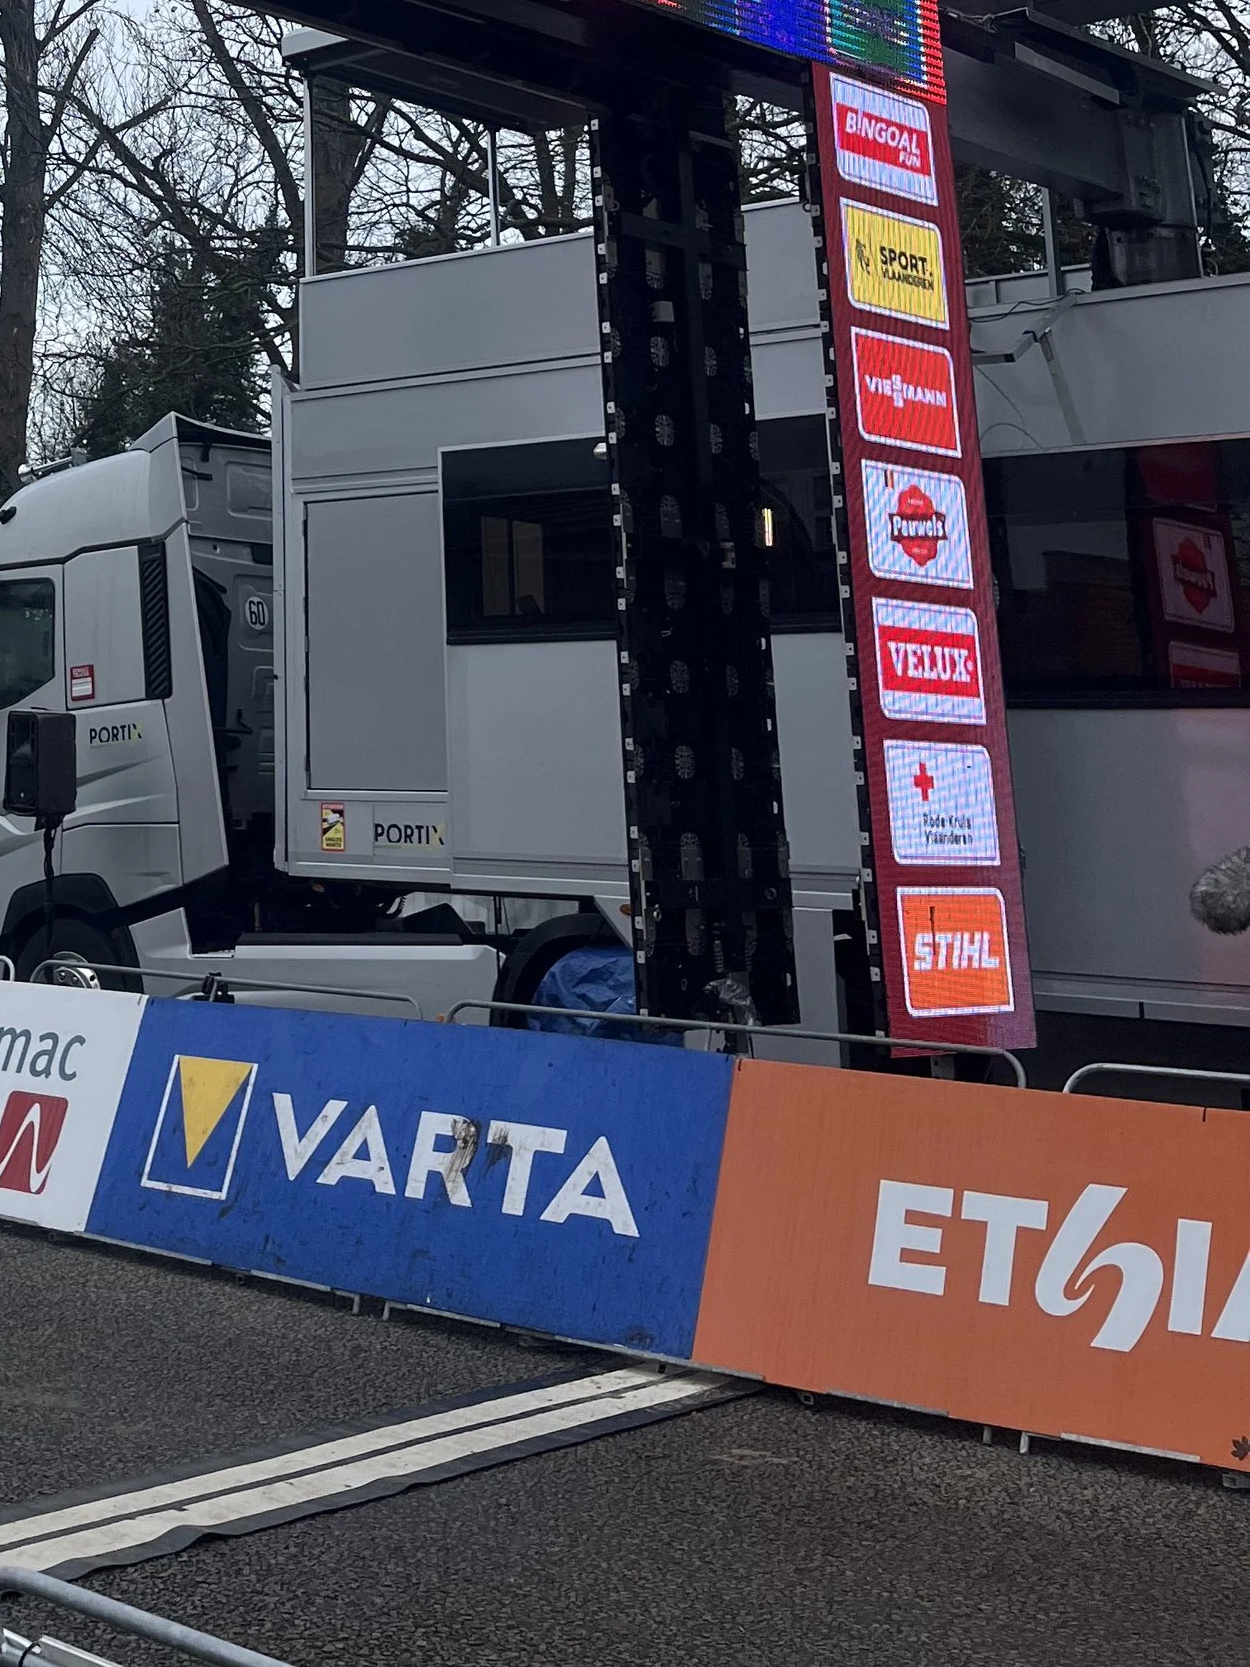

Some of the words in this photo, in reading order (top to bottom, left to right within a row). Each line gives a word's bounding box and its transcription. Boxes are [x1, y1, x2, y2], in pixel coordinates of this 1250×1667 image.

[845, 111, 920, 155] BINGOAL
[249, 600, 265, 626] 60
[374, 823, 445, 845] PORTIX
[914, 931, 999, 971] STIHL
[272, 1092, 640, 1238] VARTA
